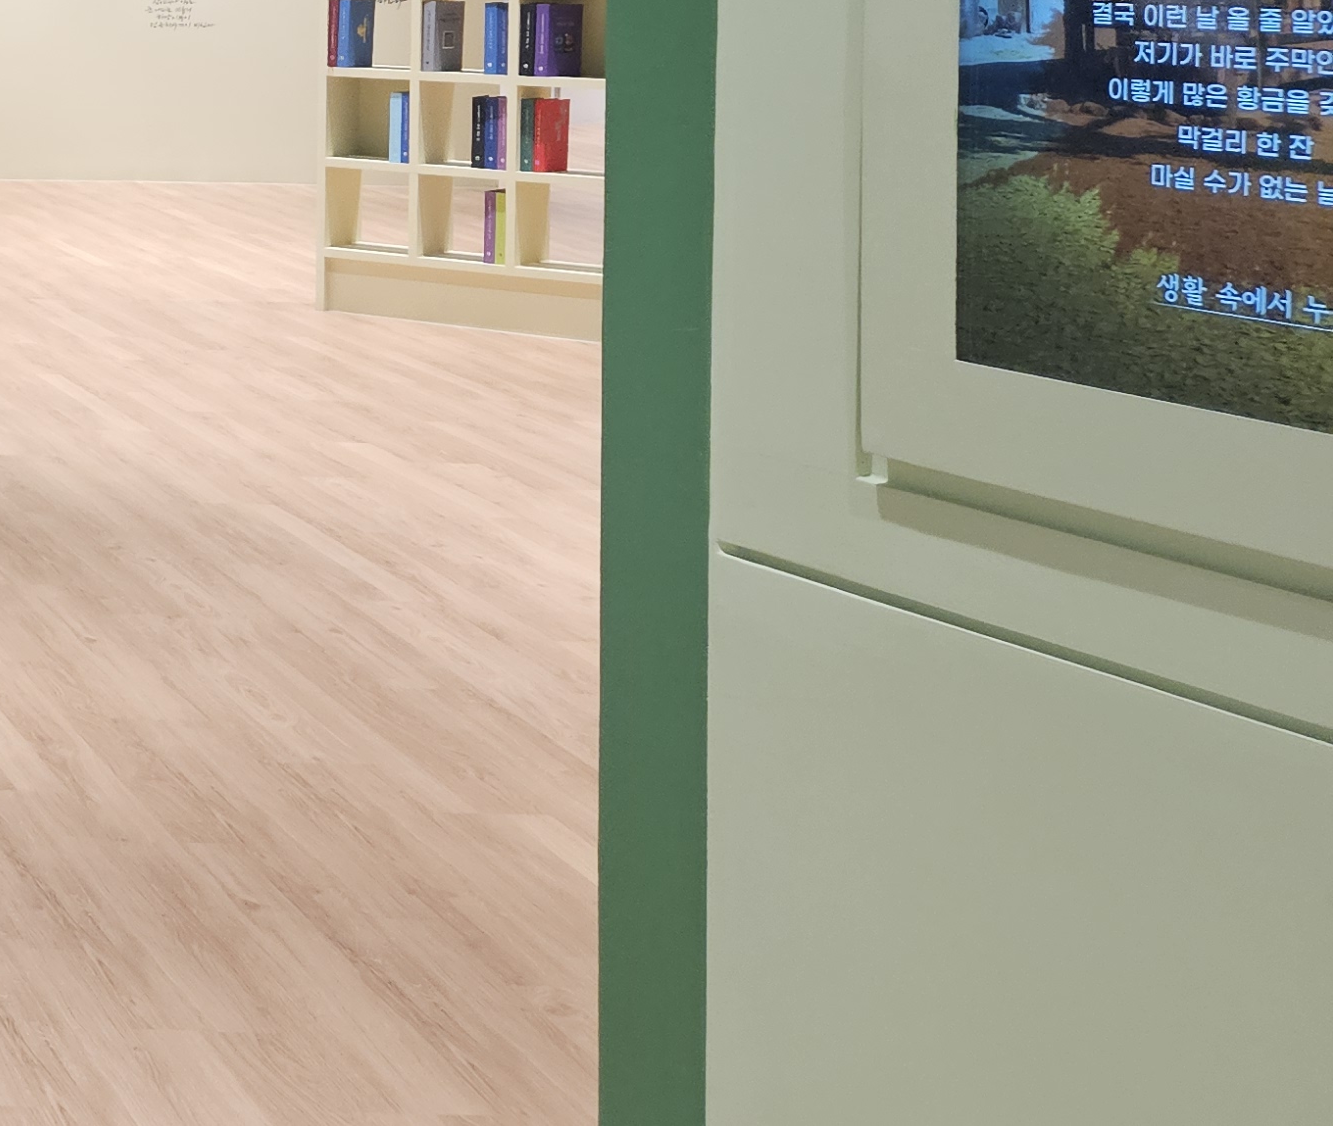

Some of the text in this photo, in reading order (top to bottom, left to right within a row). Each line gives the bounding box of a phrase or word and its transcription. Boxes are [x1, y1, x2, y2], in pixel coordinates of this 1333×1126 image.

[1092, 2, 1135, 26] 결국
[1143, 4, 1187, 28] 이런
[1196, 5, 1219, 30] 날
[1227, 7, 1250, 31] 올
[1259, 8, 1282, 33] 줄
[1134, 41, 1203, 68] 저기가
[1210, 44, 1257, 70] 바로
[1108, 78, 1174, 104] 이렇게
[1182, 82, 1228, 108] 많은
[1237, 85, 1310, 115] 황금을
[1177, 125, 1315, 160] 막걸리 한 잔
[1150, 164, 1196, 191] 마실
[1203, 170, 1252, 196] 수가
[1259, 174, 1309, 203] 없는
[1156, 274, 1207, 306] 생활
[1215, 281, 1293, 320] 속에서
